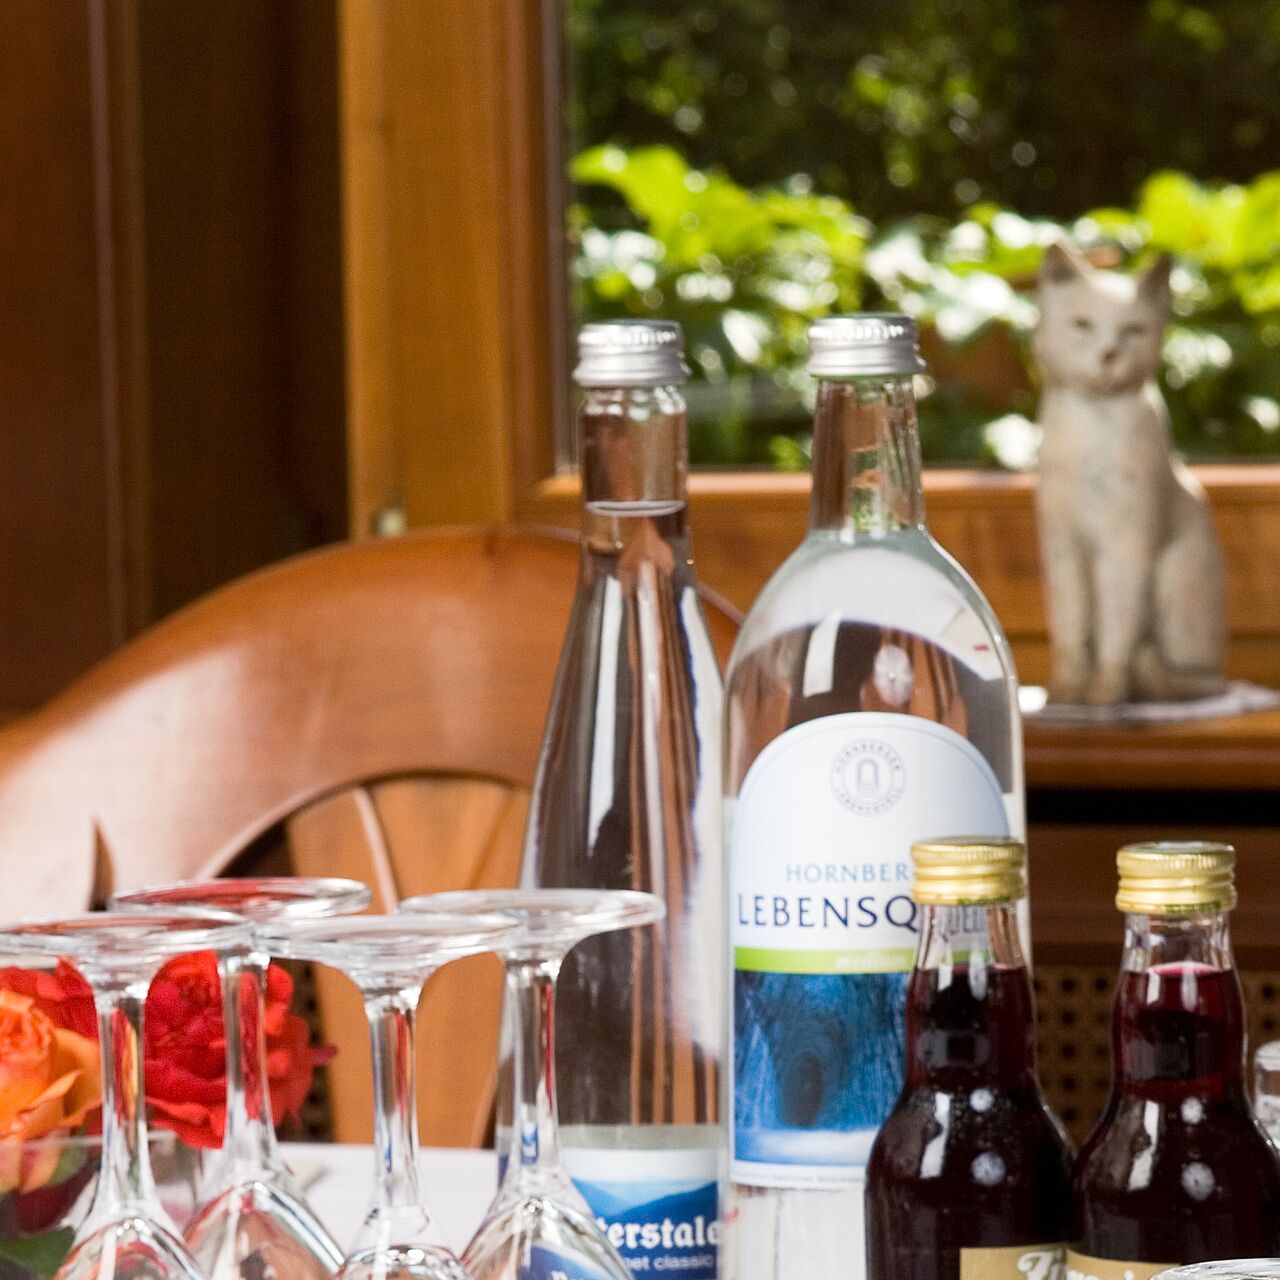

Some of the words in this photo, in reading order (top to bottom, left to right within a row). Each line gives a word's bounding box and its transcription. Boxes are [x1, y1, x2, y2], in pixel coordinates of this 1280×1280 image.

[785, 862, 909, 884] HORNBER
[737, 894, 919, 933] LEBENSQ
[653, 1254, 714, 1271] classic
